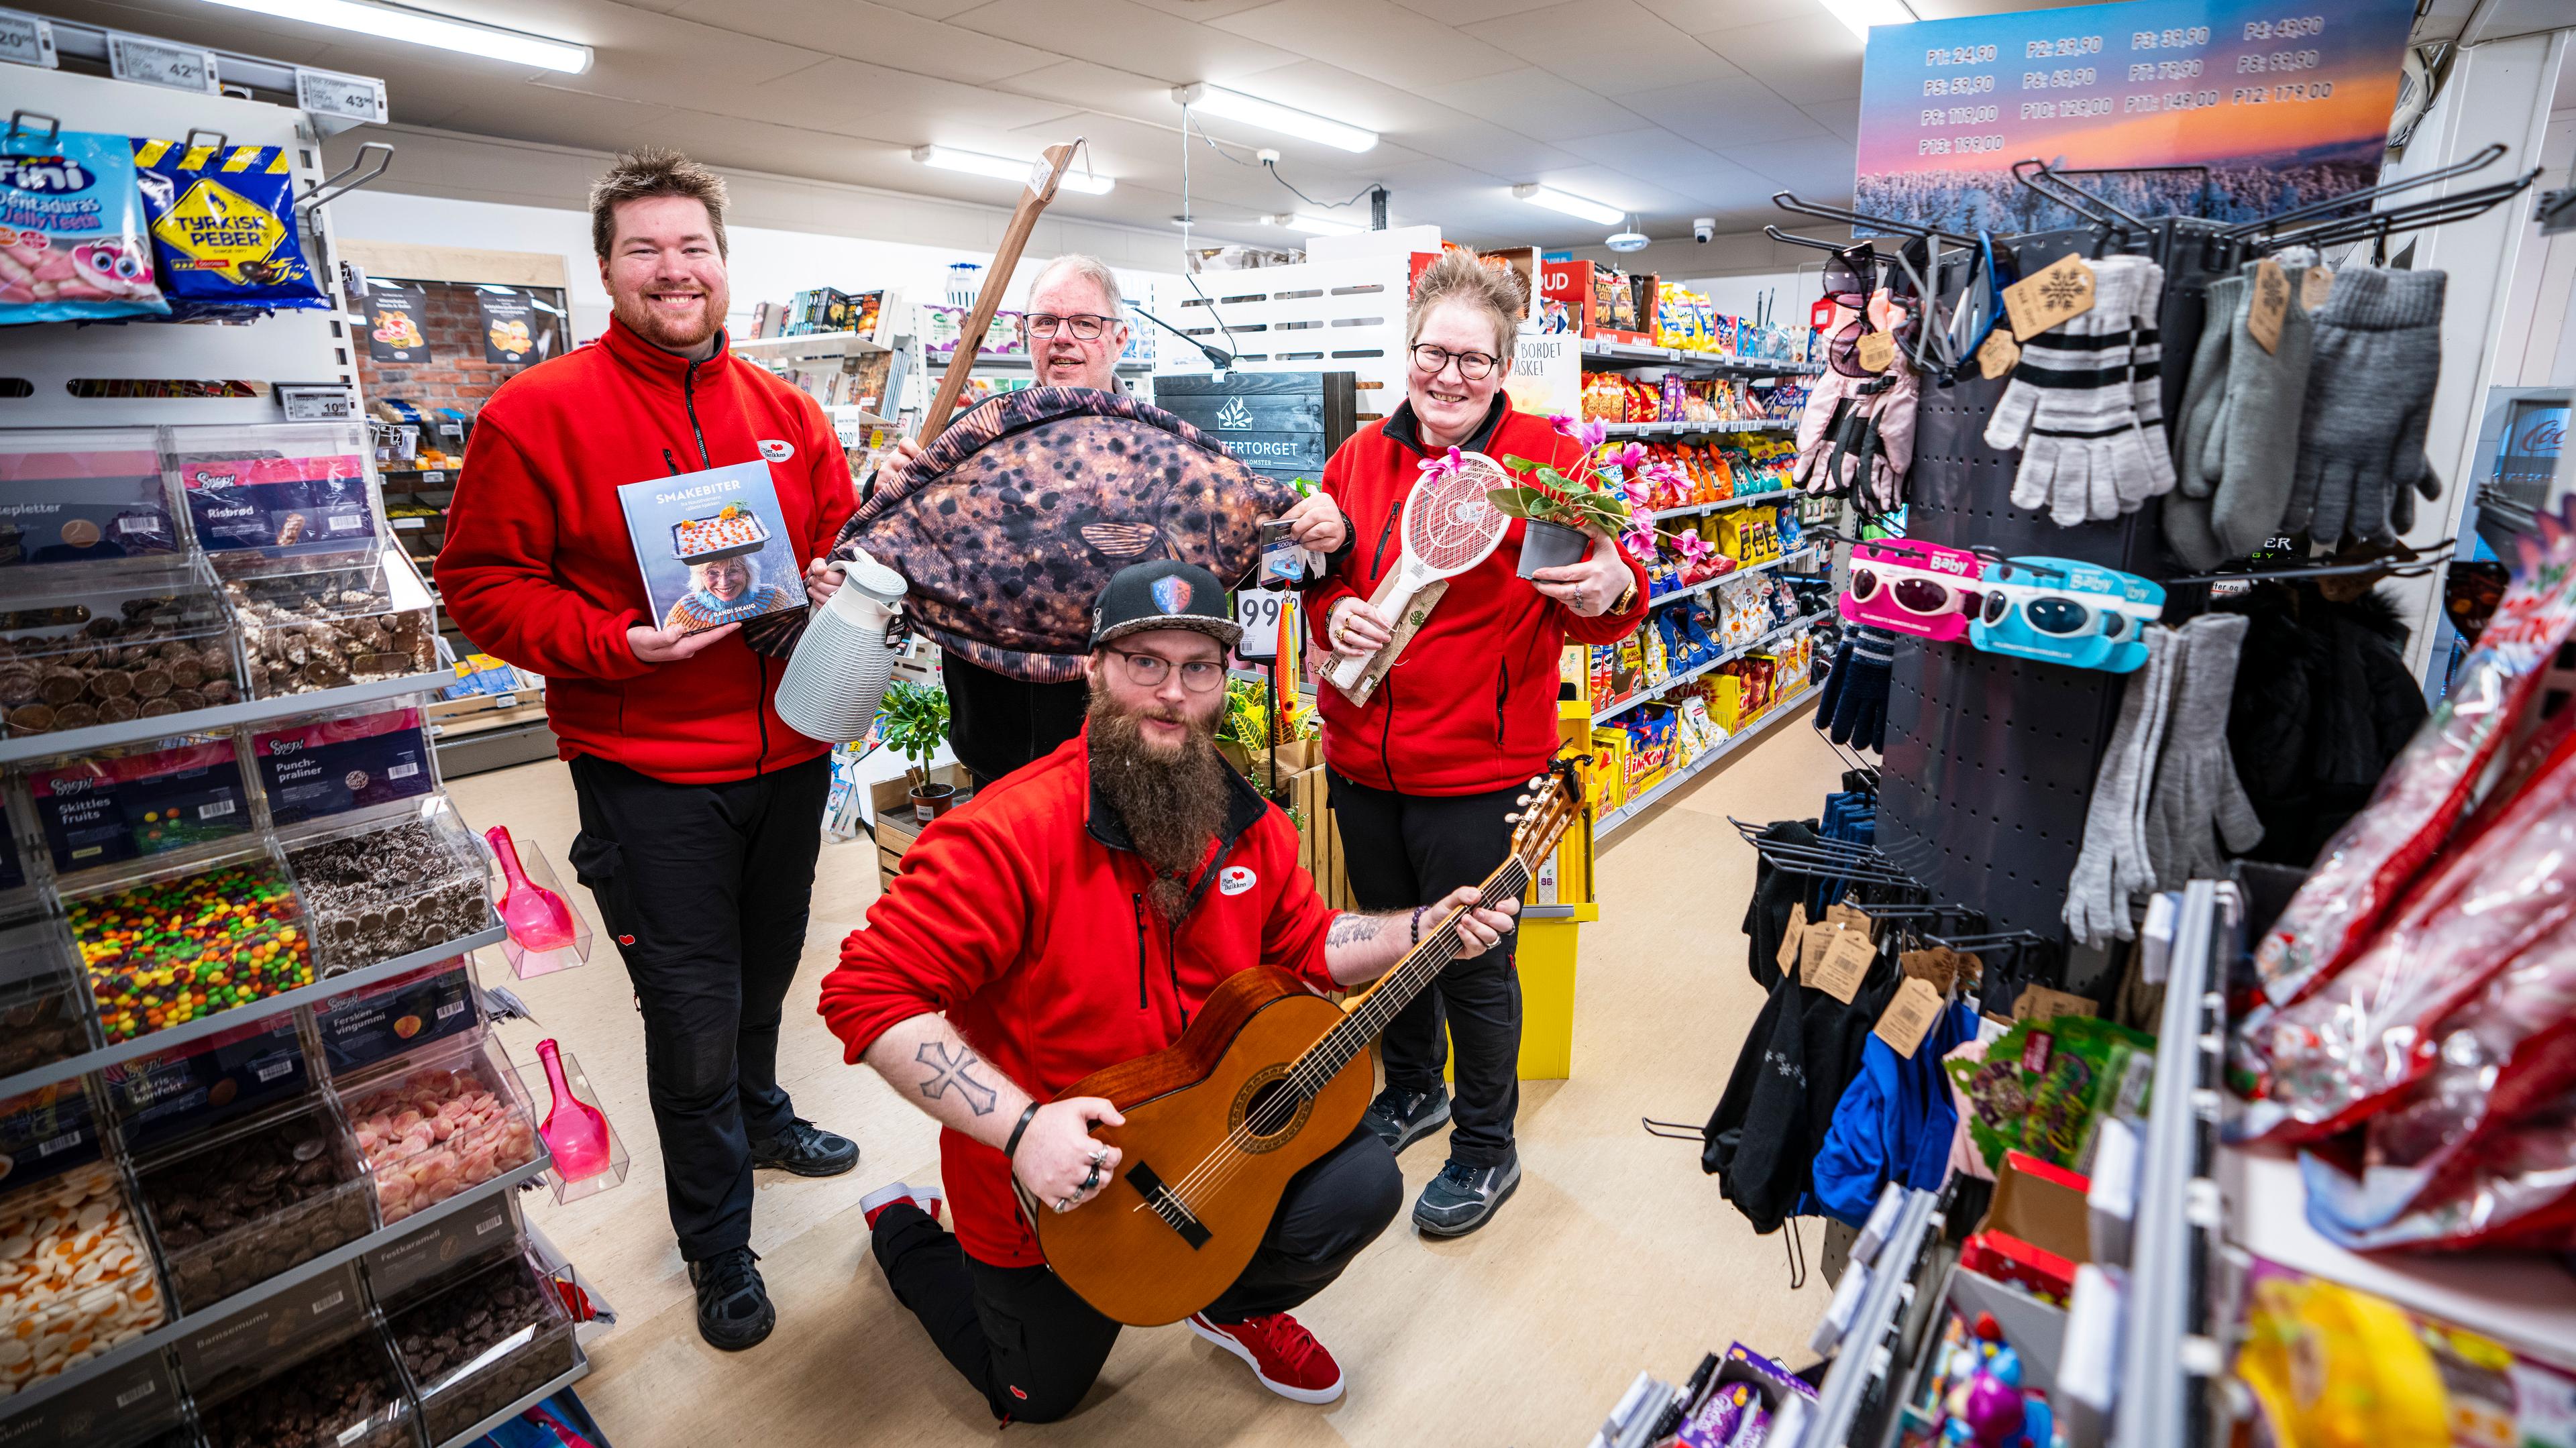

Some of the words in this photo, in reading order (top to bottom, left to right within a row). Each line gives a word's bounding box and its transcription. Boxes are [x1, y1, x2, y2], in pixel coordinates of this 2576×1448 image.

[2131, 32, 2158, 50] P3:
[2160, 26, 2210, 48] 39,90
[2243, 21, 2272, 40] P4:
[1926, 49, 1949, 66] P1:
[1952, 45, 1997, 64] 24,90
[2027, 40, 2053, 58] P2:
[2055, 36, 2102, 56] 29,90
[2023, 72, 2049, 89] P6:
[2050, 68, 2096, 87] 69,90
[2128, 63, 2155, 81] P7:
[2157, 59, 2204, 80] 79,90
[1923, 79, 1948, 96] P5:
[1951, 75, 1994, 95] 59,90
[2274, 81, 2332, 102] 179,00
[2021, 103, 2056, 119] P10:
[2059, 98, 2112, 117] 129,00
[2125, 95, 2158, 112] P11:
[2163, 90, 2220, 111] 149,00
[1921, 109, 1945, 125] P9:
[1949, 105, 1998, 124] 119,00
[1919, 139, 1951, 155] P13:
[1955, 135, 2004, 154] 199,00
[3, 209, 48, 229] Jelly
[191, 231, 262, 247] PEBER
[1521, 342, 1562, 359] BORDET
[655, 480, 741, 505] SMAKEBITER
[207, 505, 254, 519] Risbrød
[1277, 541, 1293, 549] 500g
[2263, 537, 2292, 551] ER
[1929, 555, 1969, 576] Baby
[2070, 573, 2114, 594] Baby
[2214, 582, 2226, 590] ter
[2229, 584, 2239, 594] og
[713, 608, 734, 618] RANDI
[734, 603, 756, 613] SKAUG
[276, 759, 317, 772] Punch-
[279, 766, 323, 783] praliner
[58, 797, 111, 814] Skittles
[333, 1009, 372, 1027] Fersken
[335, 1011, 386, 1036] vingummi
[133, 1082, 183, 1105] konfekt
[380, 1228, 441, 1262] Festkaramell
[197, 1311, 269, 1350] Bamsemums
